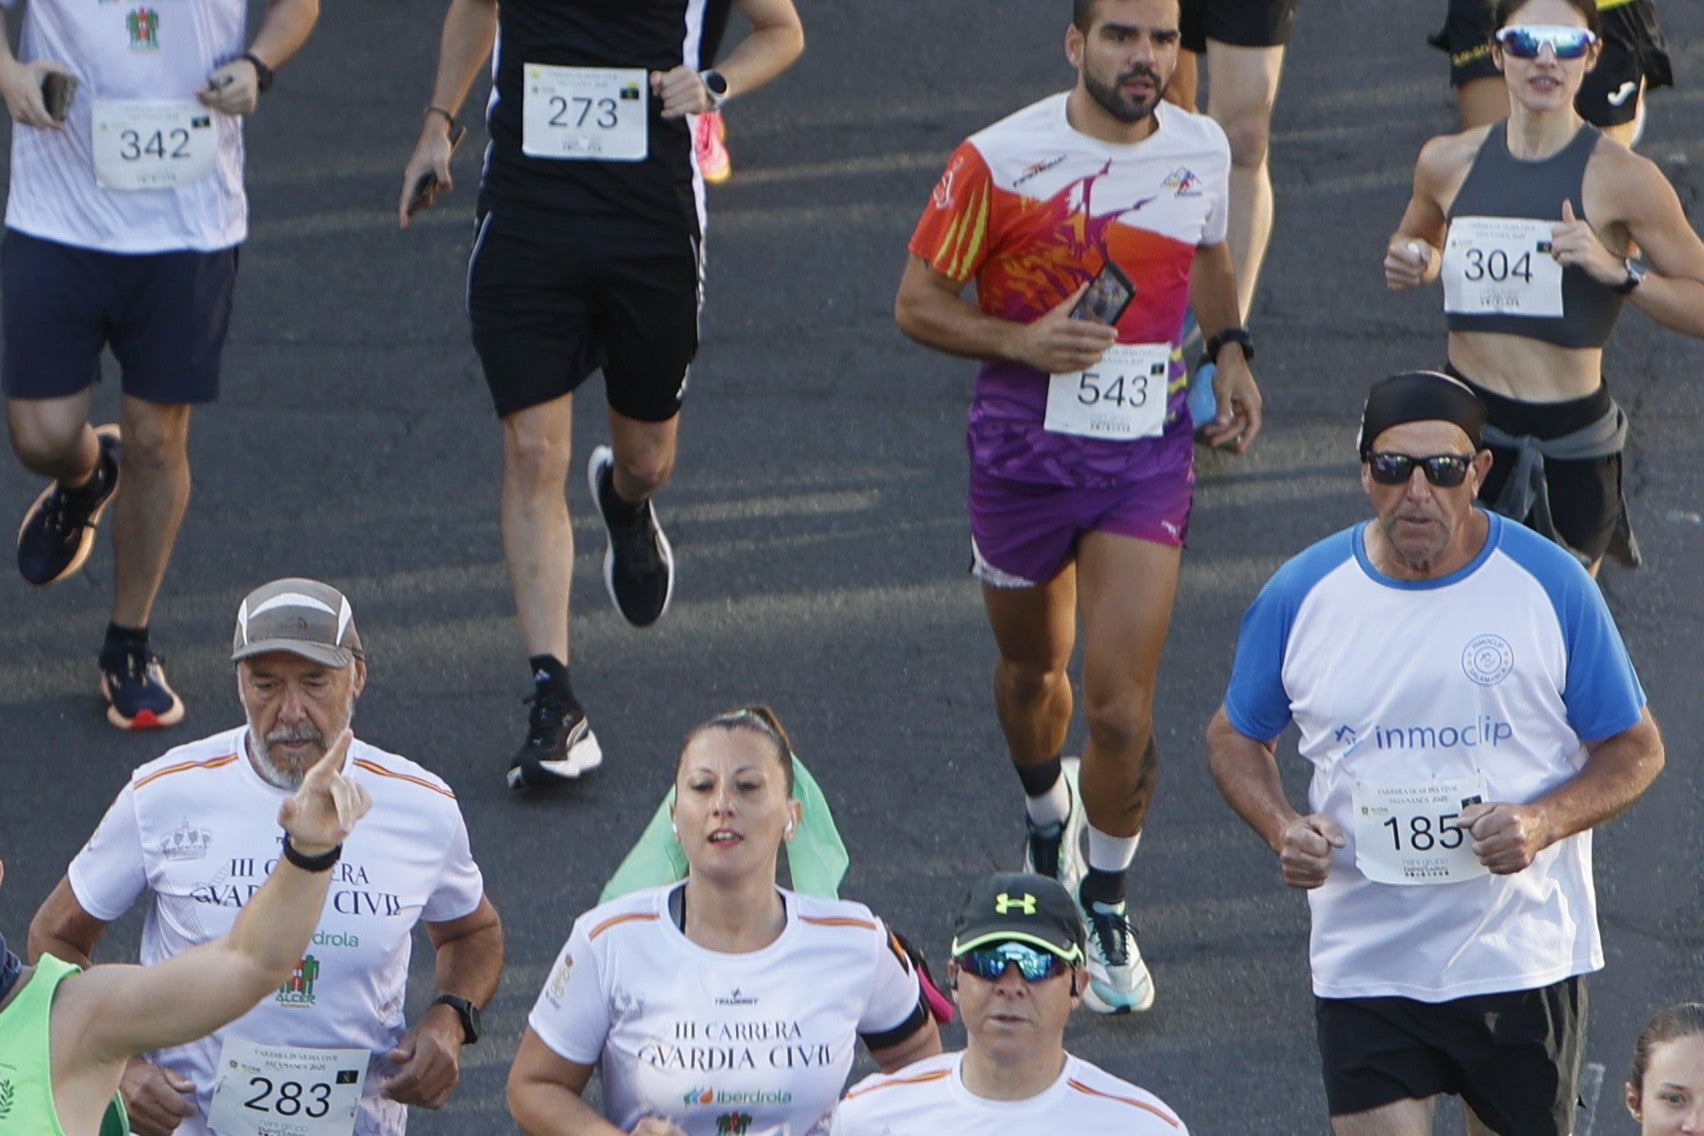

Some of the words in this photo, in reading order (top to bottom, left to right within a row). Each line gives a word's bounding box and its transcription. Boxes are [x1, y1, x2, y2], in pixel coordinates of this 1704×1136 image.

[548, 96, 618, 128] 273
[120, 128, 191, 161] 342
[1464, 248, 1534, 283] 304
[1077, 372, 1148, 408] 543
[1375, 715, 1513, 749] inmoclip
[1384, 814, 1464, 851] 185
[230, 858, 254, 877] III
[264, 860, 369, 885] CERA
[312, 930, 359, 948] drola
[675, 1021, 696, 1040] III
[705, 1021, 803, 1042] CARRERA
[244, 1077, 332, 1118] 283
